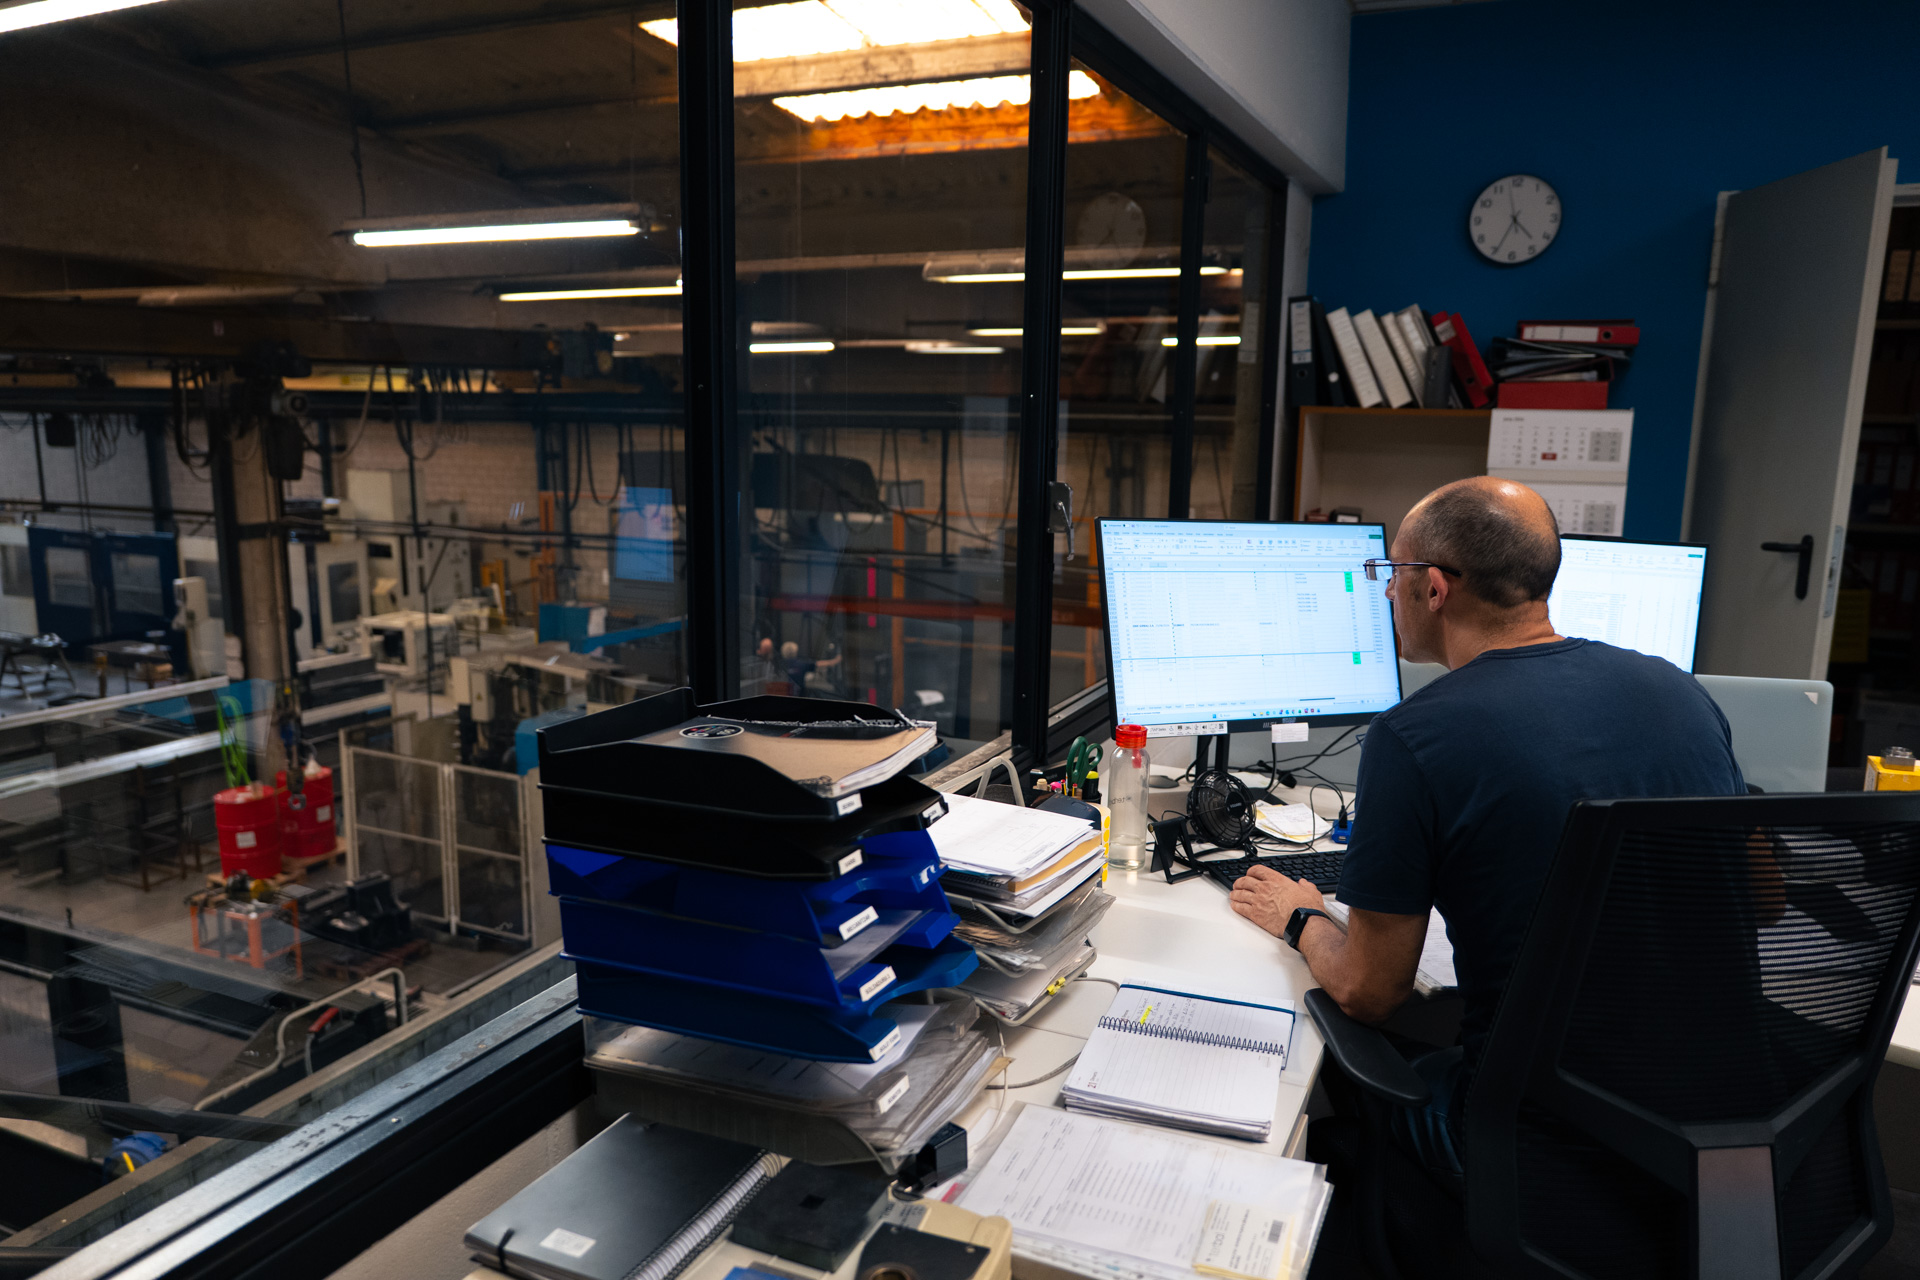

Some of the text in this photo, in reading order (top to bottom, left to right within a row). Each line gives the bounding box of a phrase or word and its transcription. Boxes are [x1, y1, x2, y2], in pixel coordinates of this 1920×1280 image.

[1512, 177, 1523, 187] 12
[1494, 185, 1503, 195] 11
[1480, 198, 1492, 208] 10
[1545, 194, 1554, 204] 2
[1473, 216, 1482, 226] 9
[1550, 212, 1559, 223] 3
[1477, 233, 1485, 244] 8
[1542, 231, 1551, 240] 4
[1527, 244, 1536, 255] 5
[1507, 250, 1516, 260] 6
